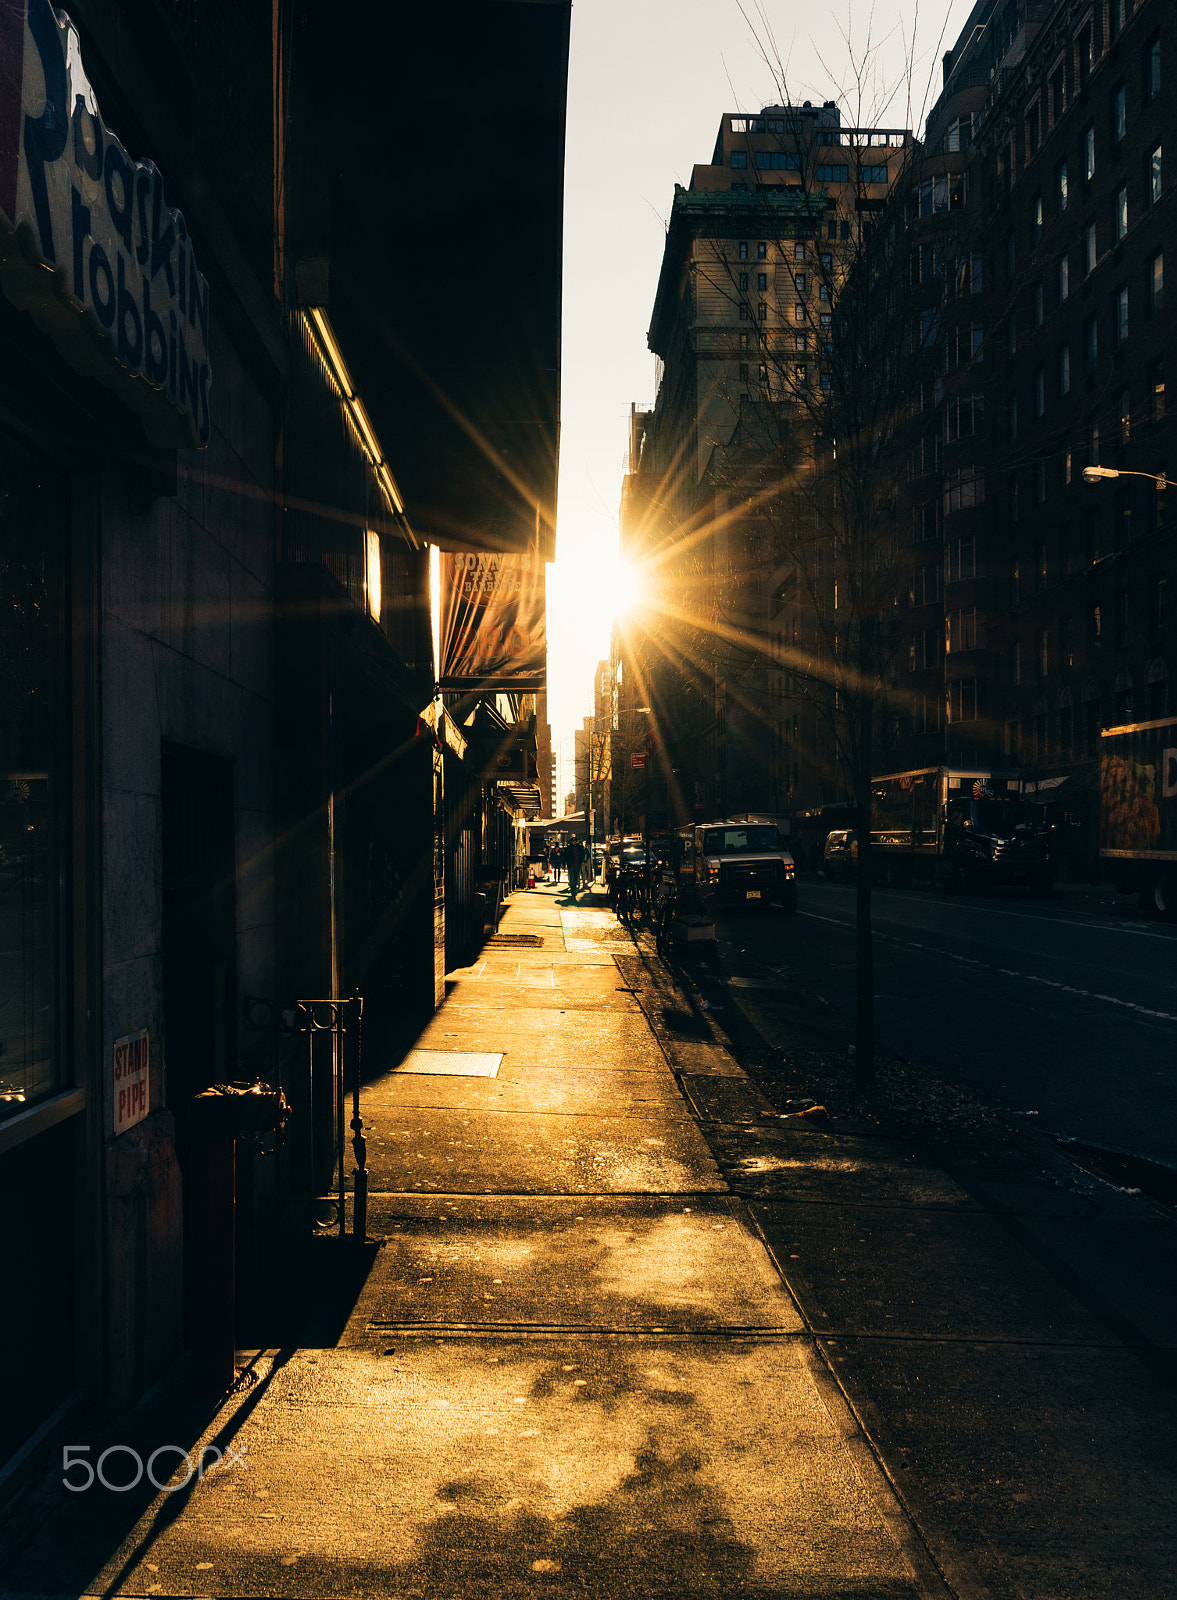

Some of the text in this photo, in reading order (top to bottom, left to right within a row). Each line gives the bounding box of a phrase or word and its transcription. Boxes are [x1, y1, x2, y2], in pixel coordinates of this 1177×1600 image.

[454, 552, 531, 571] SONN'S
[115, 1037, 148, 1081] STAND
[118, 1079, 145, 1123] PIPE
